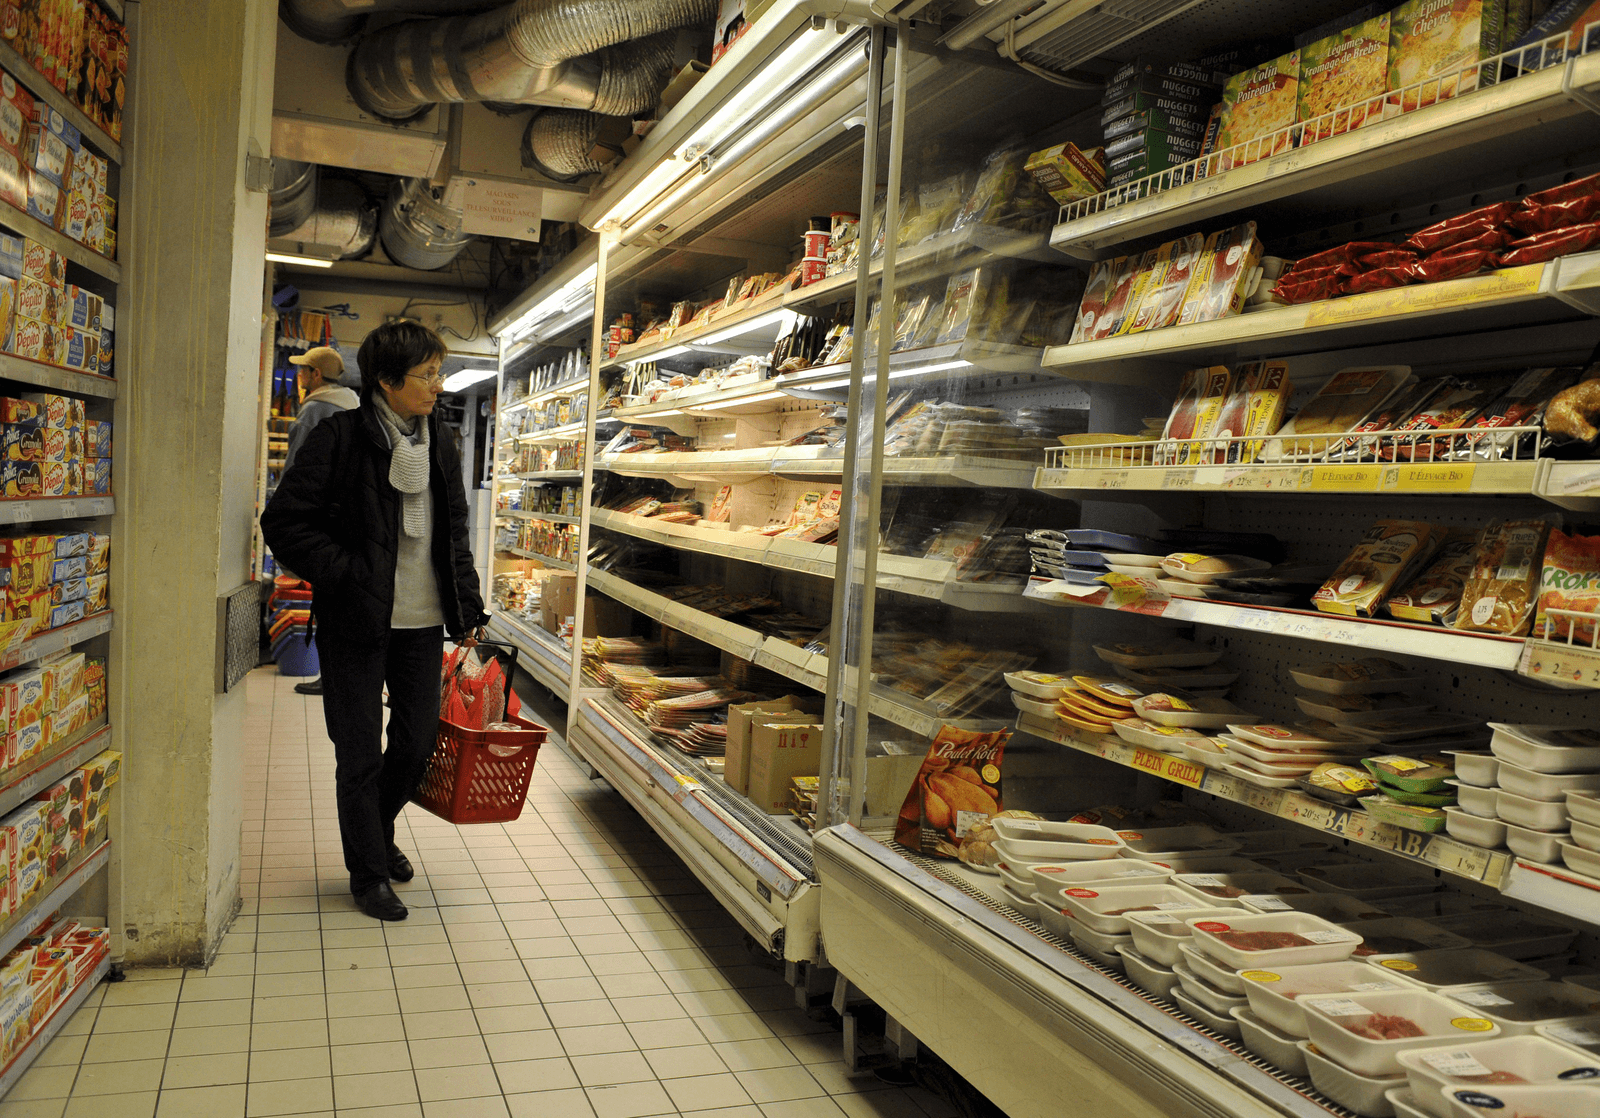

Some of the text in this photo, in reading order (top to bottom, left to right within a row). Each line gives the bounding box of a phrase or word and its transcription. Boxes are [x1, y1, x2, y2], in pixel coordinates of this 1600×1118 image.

[1412, 11, 1452, 37] Chèvre
[1327, 37, 1365, 58] Légumes
[1304, 40, 1381, 79] Fromage de Brebis
[1168, 66, 1209, 82] NUGGETS
[1253, 65, 1278, 84] Colin
[1162, 80, 1200, 97] NUGGETS
[1237, 81, 1277, 104] Poireaux
[1157, 98, 1198, 114] NUGGETS
[1169, 115, 1205, 132] NUGGETS
[1166, 135, 1202, 150] NUGGET
[1204, 122, 1217, 150] BLEU
[485, 190, 519, 200] MAGASIN
[466, 203, 536, 218] TELESURVEILLANCE
[25, 253, 45, 274] Pépito
[1498, 280, 1537, 294] Cuisinées
[20, 291, 43, 313] Pépito
[16, 332, 40, 354] Pépito
[46, 407, 65, 423] Pépito
[1255, 399, 1273, 436] ONGLETS
[45, 441, 65, 460] Pépito
[44, 474, 64, 495] Pépito
[1512, 533, 1537, 541] TRIPES
[1552, 663, 1560, 675] 2
[936, 741, 999, 761] Poulet Rôti
[1132, 750, 1200, 784] PLEIN GRILL
[772, 801, 790, 809] BAS
